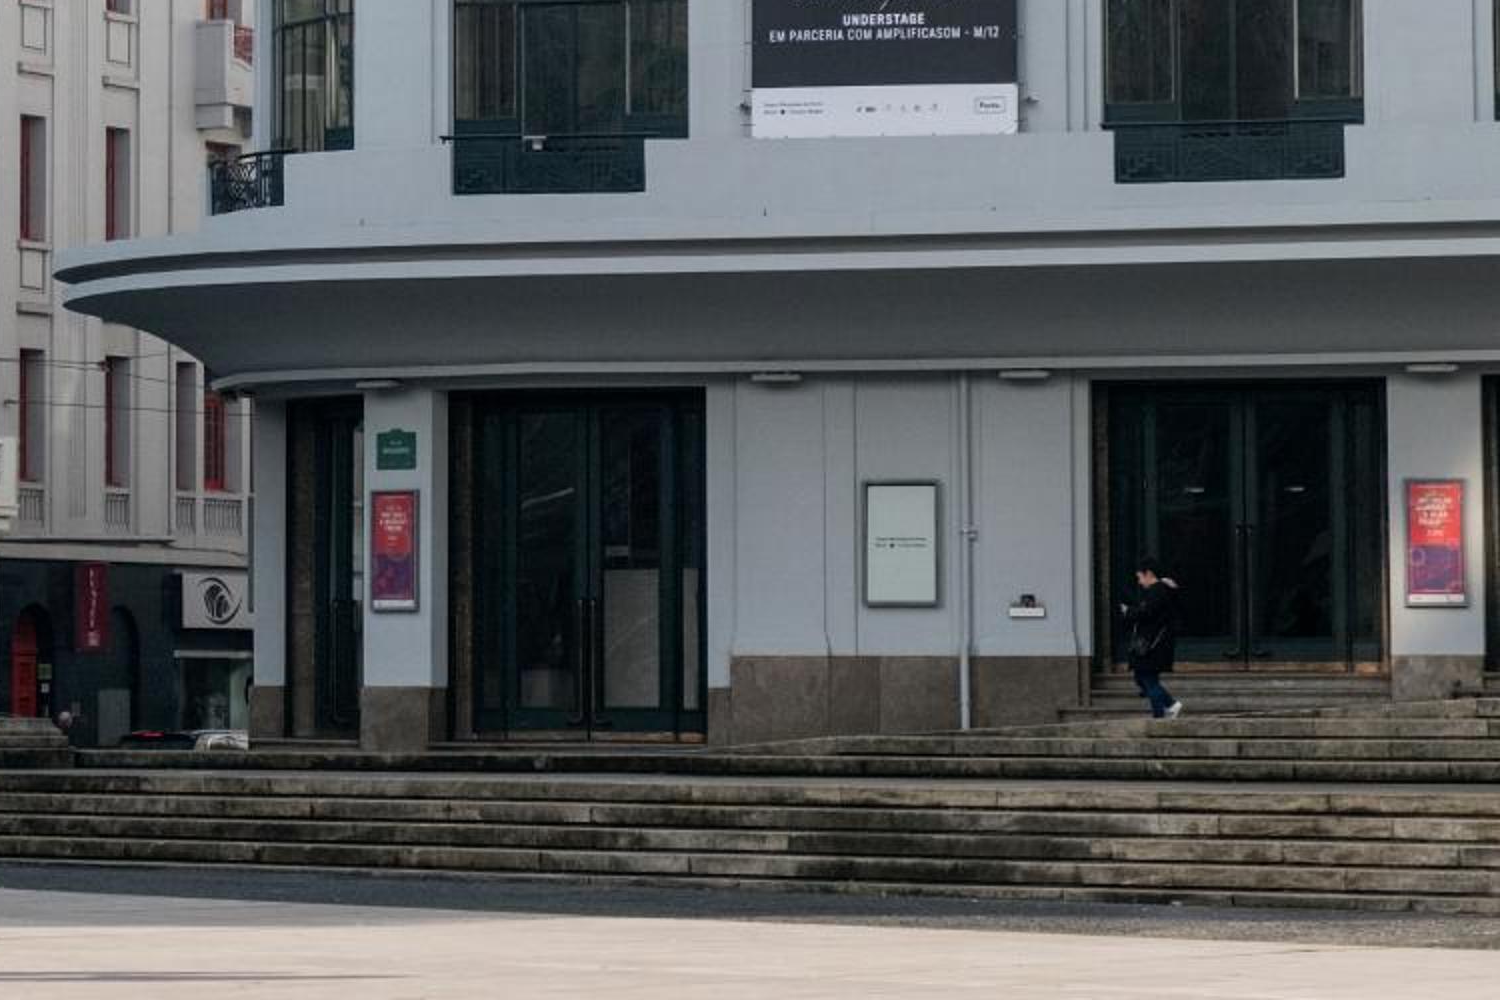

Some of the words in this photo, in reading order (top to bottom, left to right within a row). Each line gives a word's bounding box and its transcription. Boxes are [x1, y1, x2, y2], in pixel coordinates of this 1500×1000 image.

[843, 13, 926, 26] UNDERSTAGE
[770, 31, 785, 42] EM
[789, 29, 844, 42] PARCERIA
[848, 28, 873, 40] COM
[876, 26, 961, 40] AMPLIFICASOM
[973, 25, 999, 39] M/12
